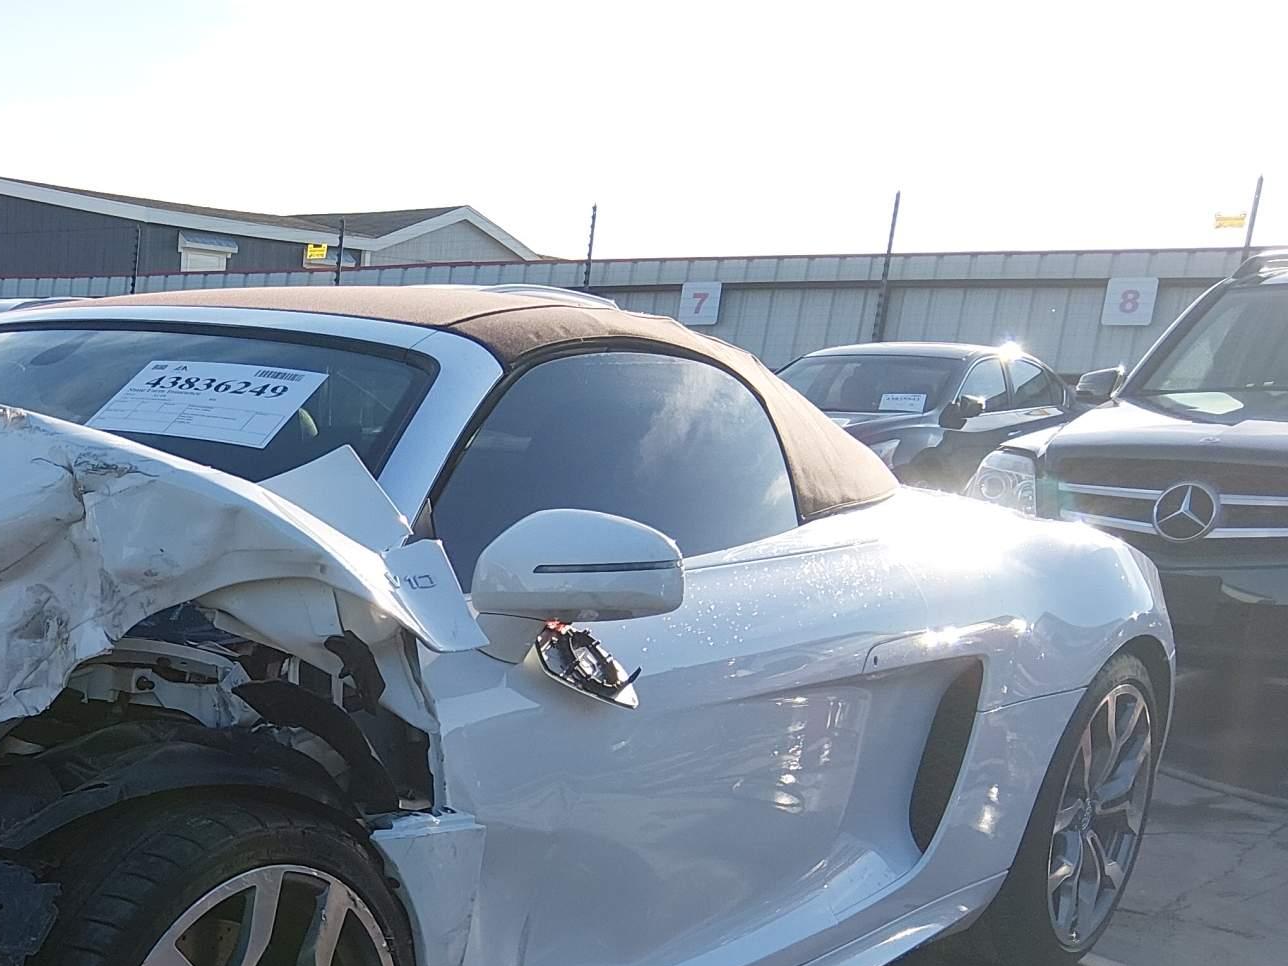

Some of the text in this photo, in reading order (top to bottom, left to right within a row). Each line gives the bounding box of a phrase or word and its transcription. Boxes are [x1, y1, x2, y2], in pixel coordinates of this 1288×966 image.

[693, 292, 710, 314] 7
[1119, 289, 1140, 314] 8
[144, 375, 289, 399] 43836249
